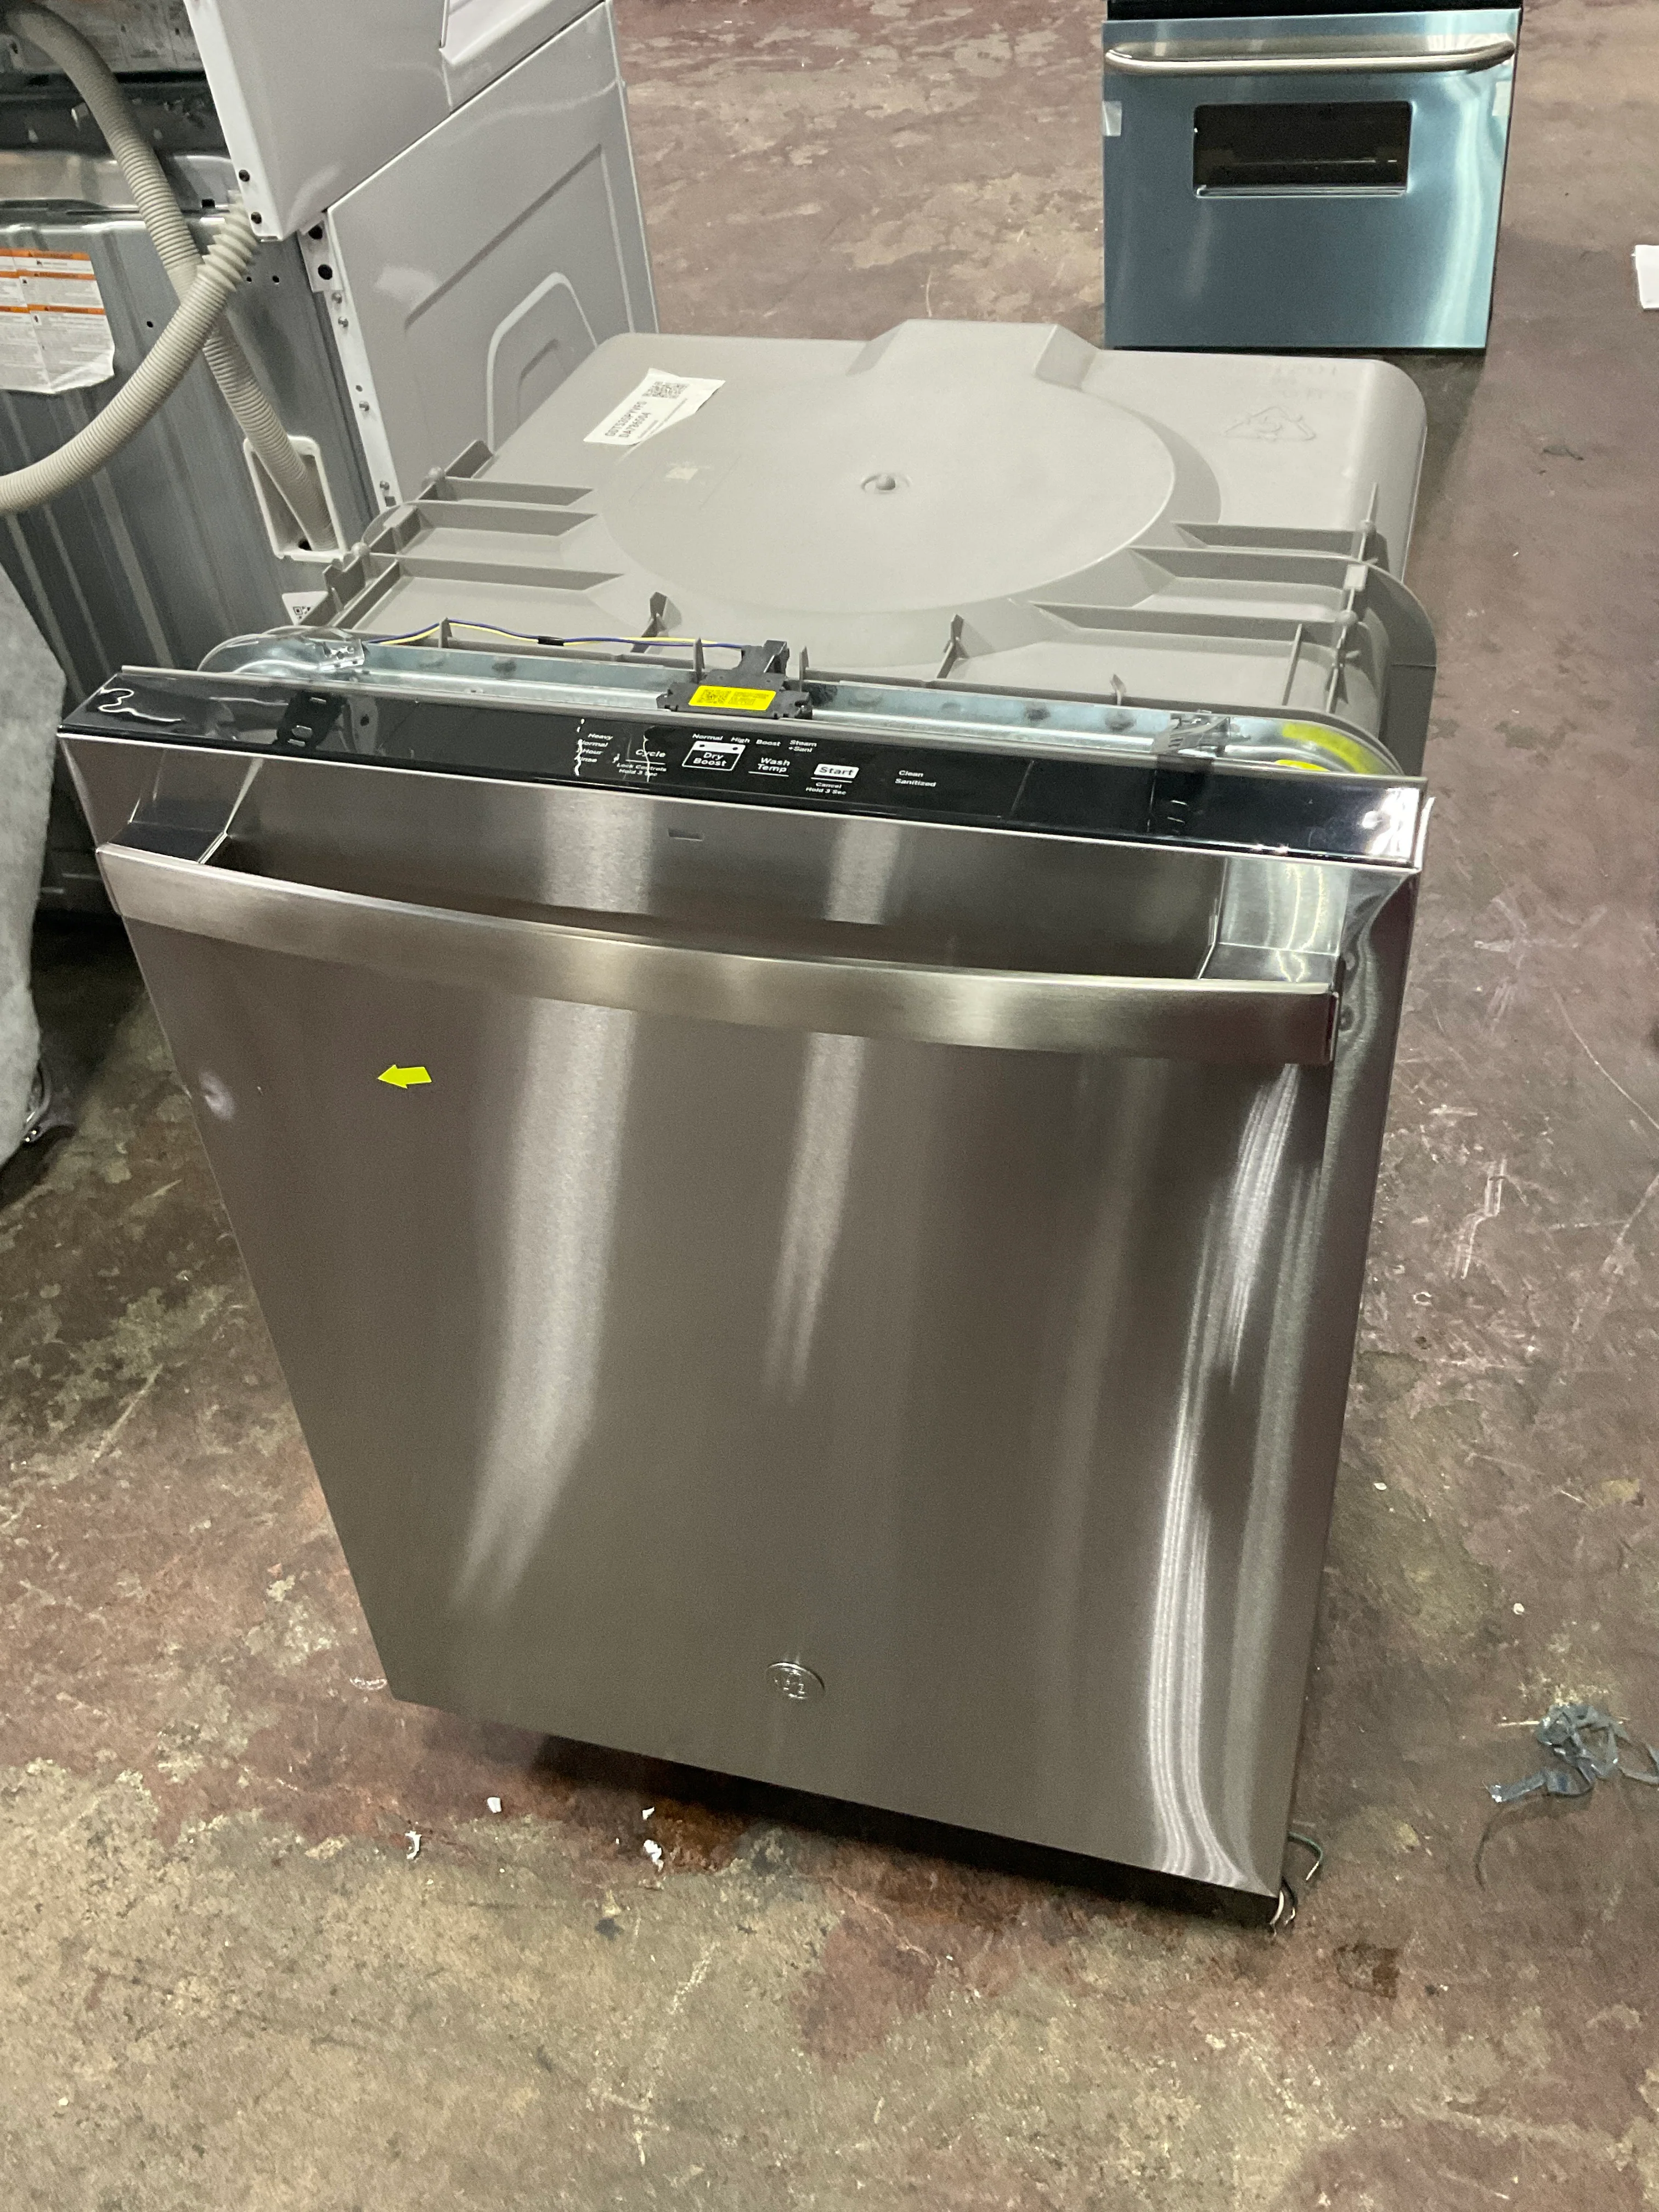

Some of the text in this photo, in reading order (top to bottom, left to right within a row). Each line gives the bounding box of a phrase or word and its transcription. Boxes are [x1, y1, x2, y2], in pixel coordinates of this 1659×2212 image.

[635, 749, 666, 758] Cycle
[703, 752, 724, 761] Dry
[693, 758, 727, 766] Boost
[760, 757, 791, 766] Wash
[758, 763, 787, 774] Temp
[819, 766, 855, 776] Start
[895, 778, 937, 787] Sanitized
